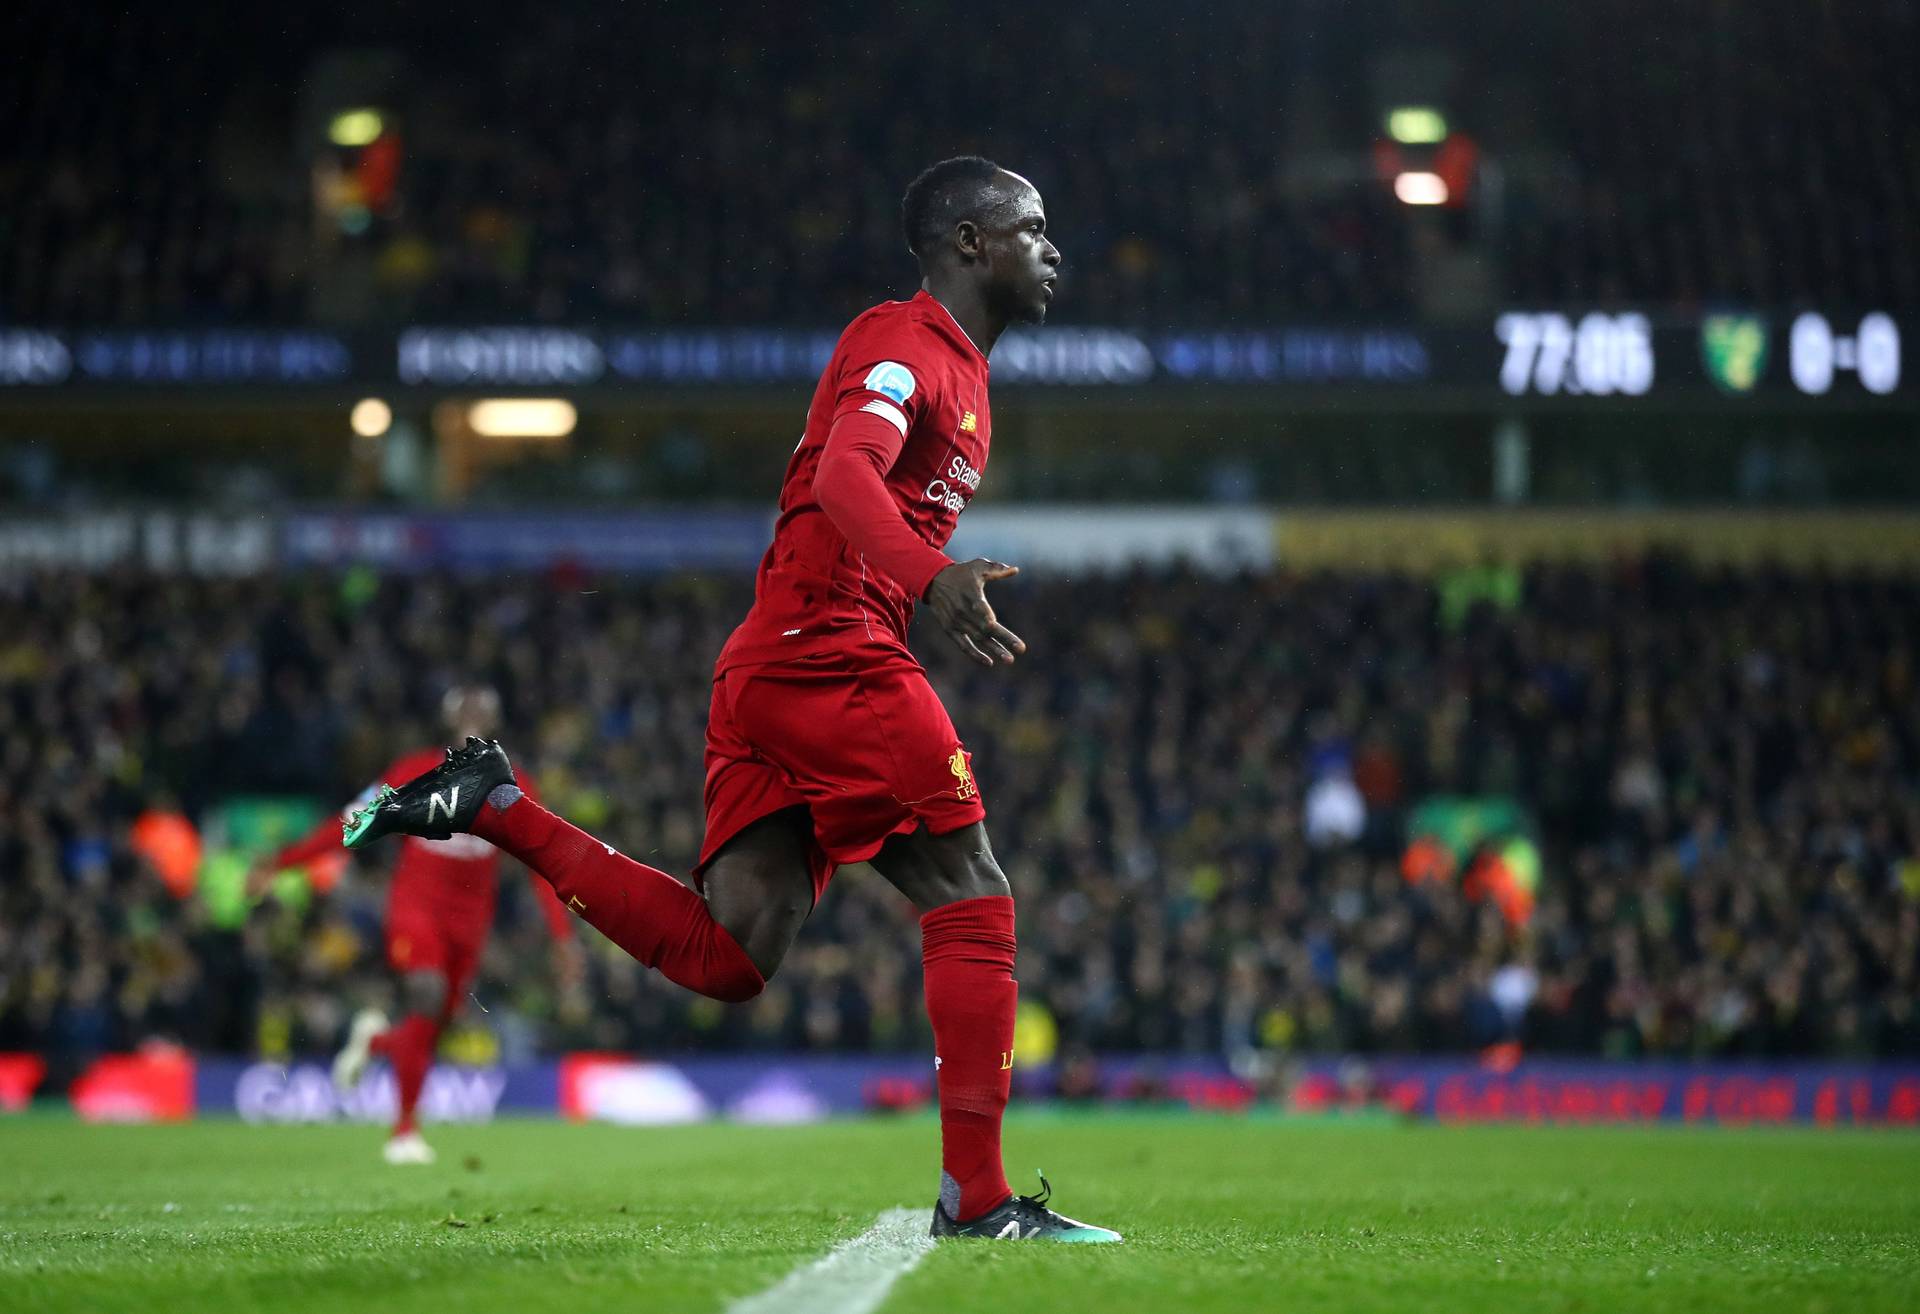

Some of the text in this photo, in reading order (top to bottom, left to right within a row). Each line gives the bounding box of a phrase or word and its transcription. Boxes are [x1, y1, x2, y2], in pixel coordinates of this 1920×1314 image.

[1790, 311, 1900, 395] 0-0
[427, 785, 460, 824] N
[957, 784, 976, 800] LFC
